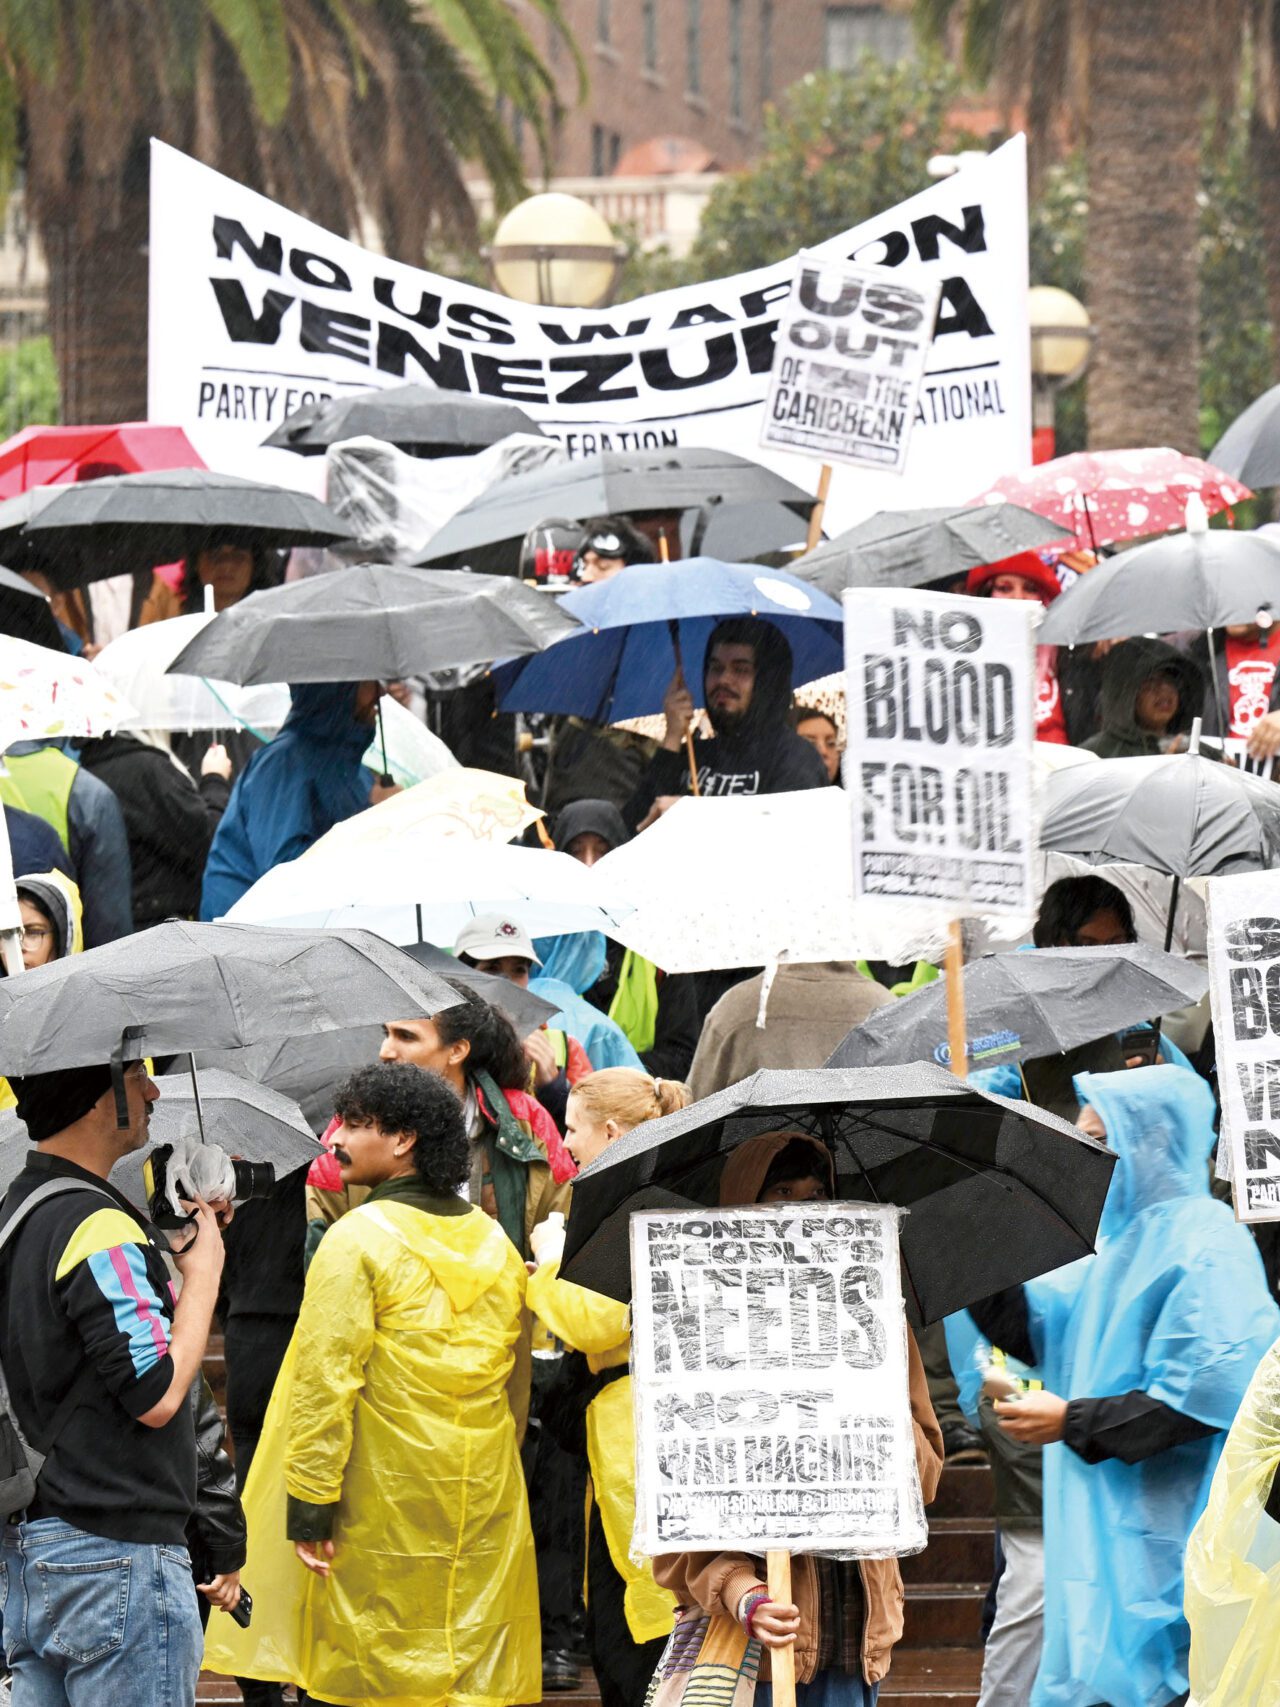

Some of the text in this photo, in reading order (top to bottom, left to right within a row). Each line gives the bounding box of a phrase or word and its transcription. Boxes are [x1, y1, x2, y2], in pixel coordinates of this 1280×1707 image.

[210, 214, 352, 292] NO
[373, 276, 516, 345] US
[847, 204, 988, 268] ON
[798, 269, 925, 333] US
[209, 276, 996, 404] VENEZUA
[788, 318, 920, 368] OUT
[197, 380, 280, 421] PARTY
[780, 356, 913, 409] OF THE
[772, 387, 906, 445] CARIBBEAN
[891, 607, 984, 654] NO
[863, 653, 1015, 748] BLOOD
[861, 762, 1022, 853] FOR OIL
[648, 1217, 884, 1242] MONEY FOR
[651, 1265, 888, 1374] NEEDS
[653, 1388, 834, 1433] NOT
[656, 1433, 895, 1486] WAR MACHINE
